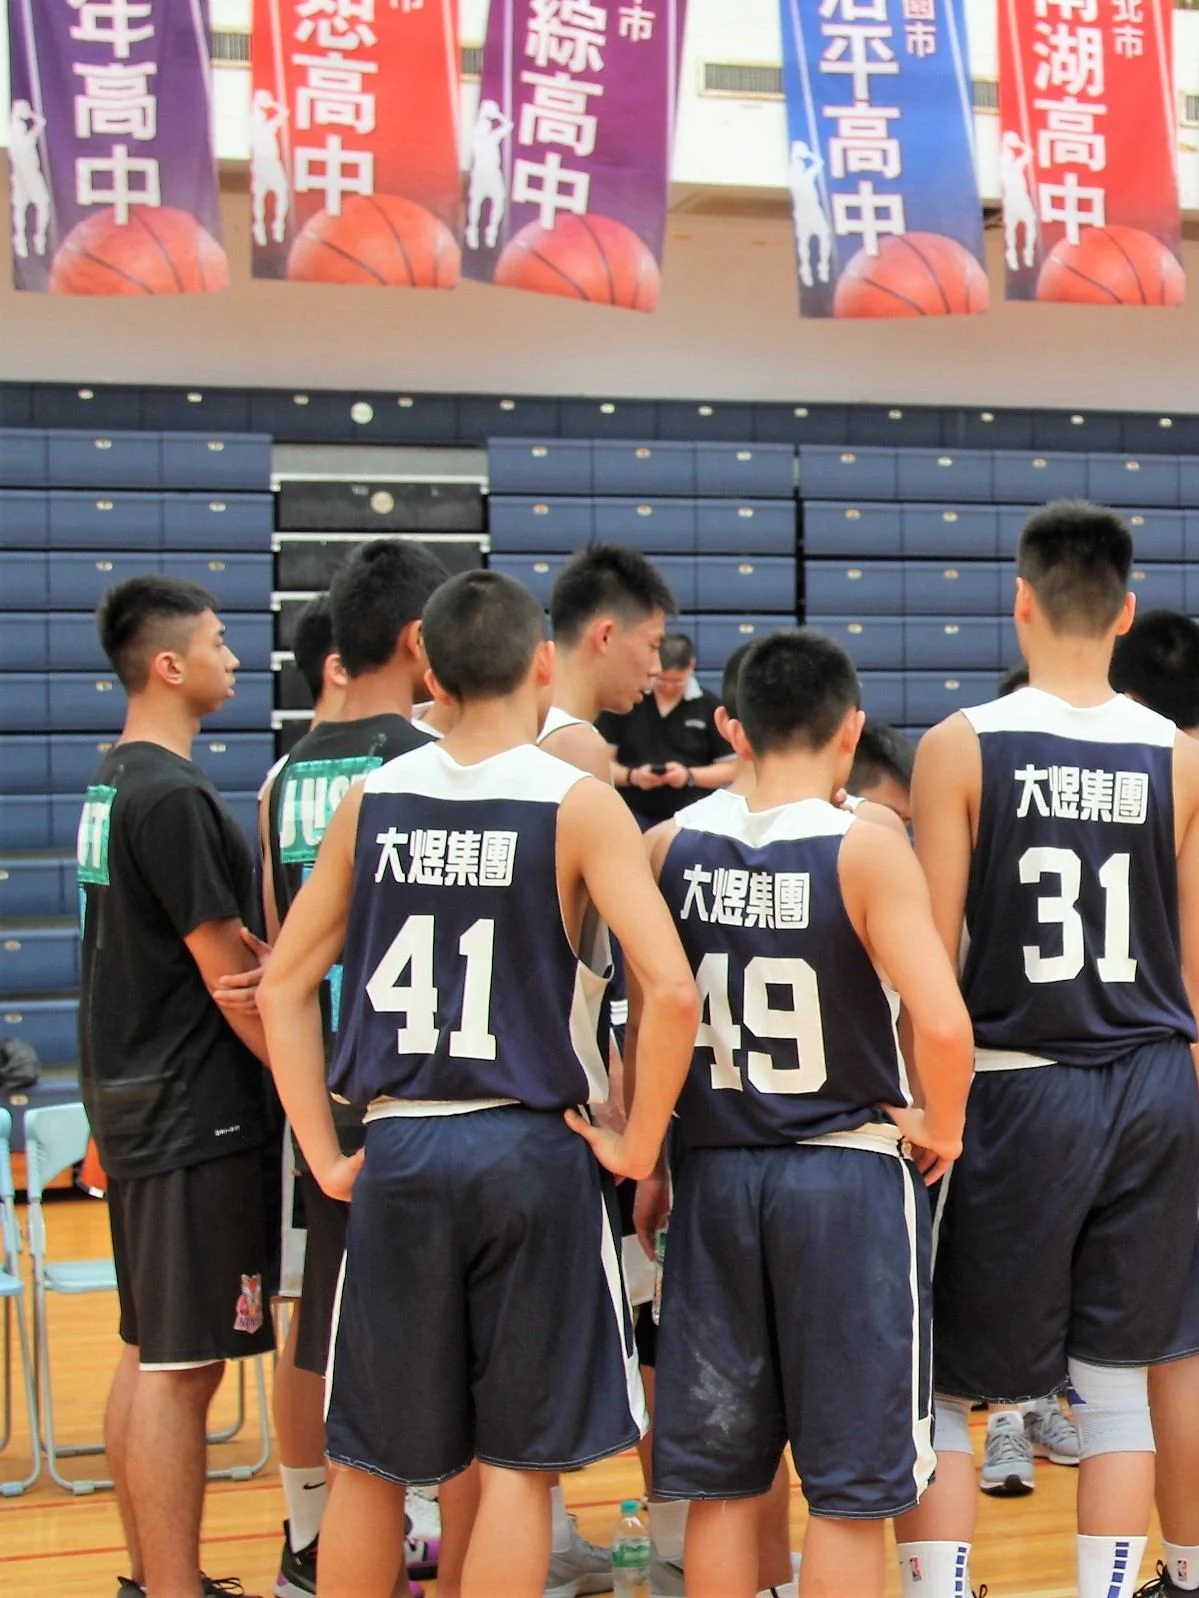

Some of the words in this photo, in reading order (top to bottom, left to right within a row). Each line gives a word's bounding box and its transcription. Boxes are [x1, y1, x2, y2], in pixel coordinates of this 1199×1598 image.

[280, 773, 367, 849] JUS
[1014, 764, 1149, 825] 大煜集團
[375, 826, 518, 888] 大煜集團
[681, 864, 810, 930] 大煜集團
[1018, 846, 1138, 983] 31
[365, 914, 497, 1060] 41
[694, 952, 828, 1095] 49
